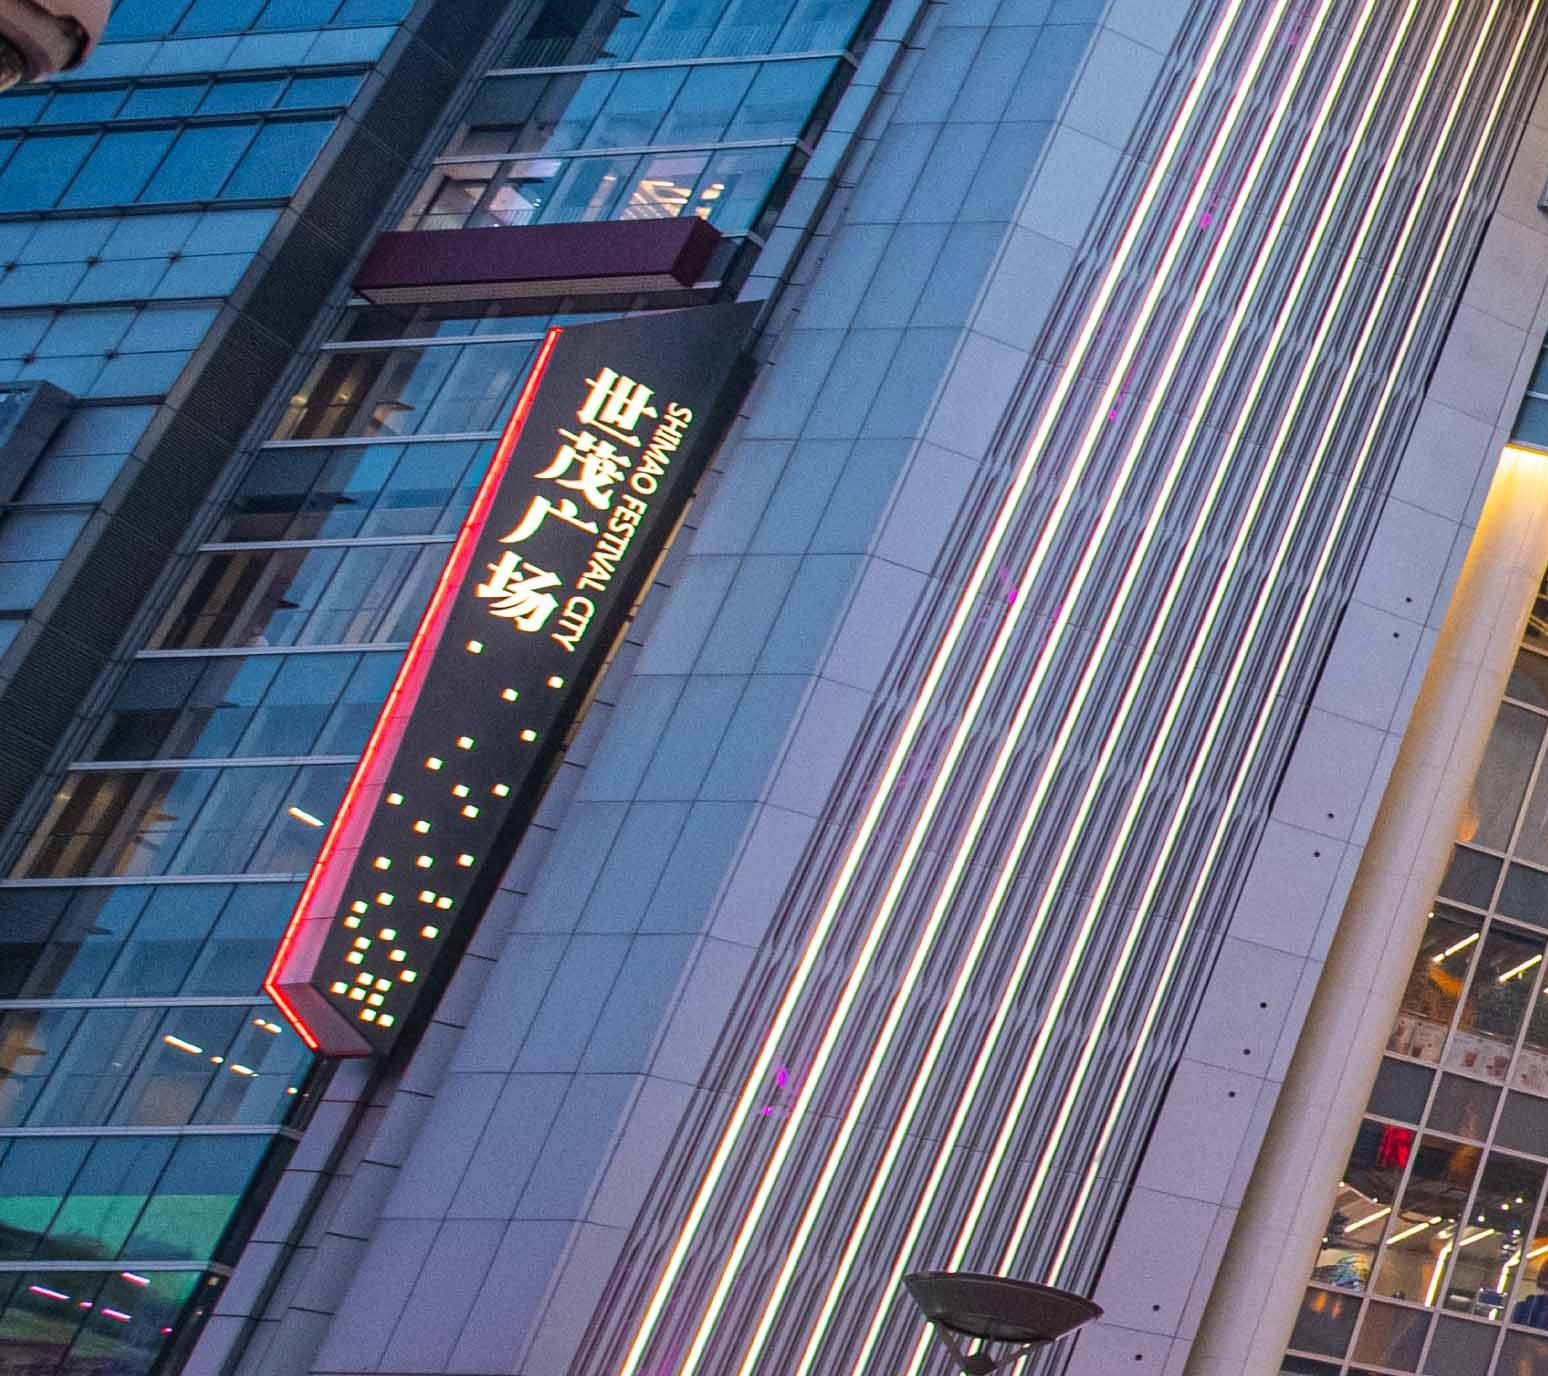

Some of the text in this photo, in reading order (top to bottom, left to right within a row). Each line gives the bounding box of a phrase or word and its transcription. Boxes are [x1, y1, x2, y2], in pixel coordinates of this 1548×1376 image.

[475, 367, 658, 632] 世茂广场
[552, 402, 693, 652] SHIMAO FESTIVAL CITY
